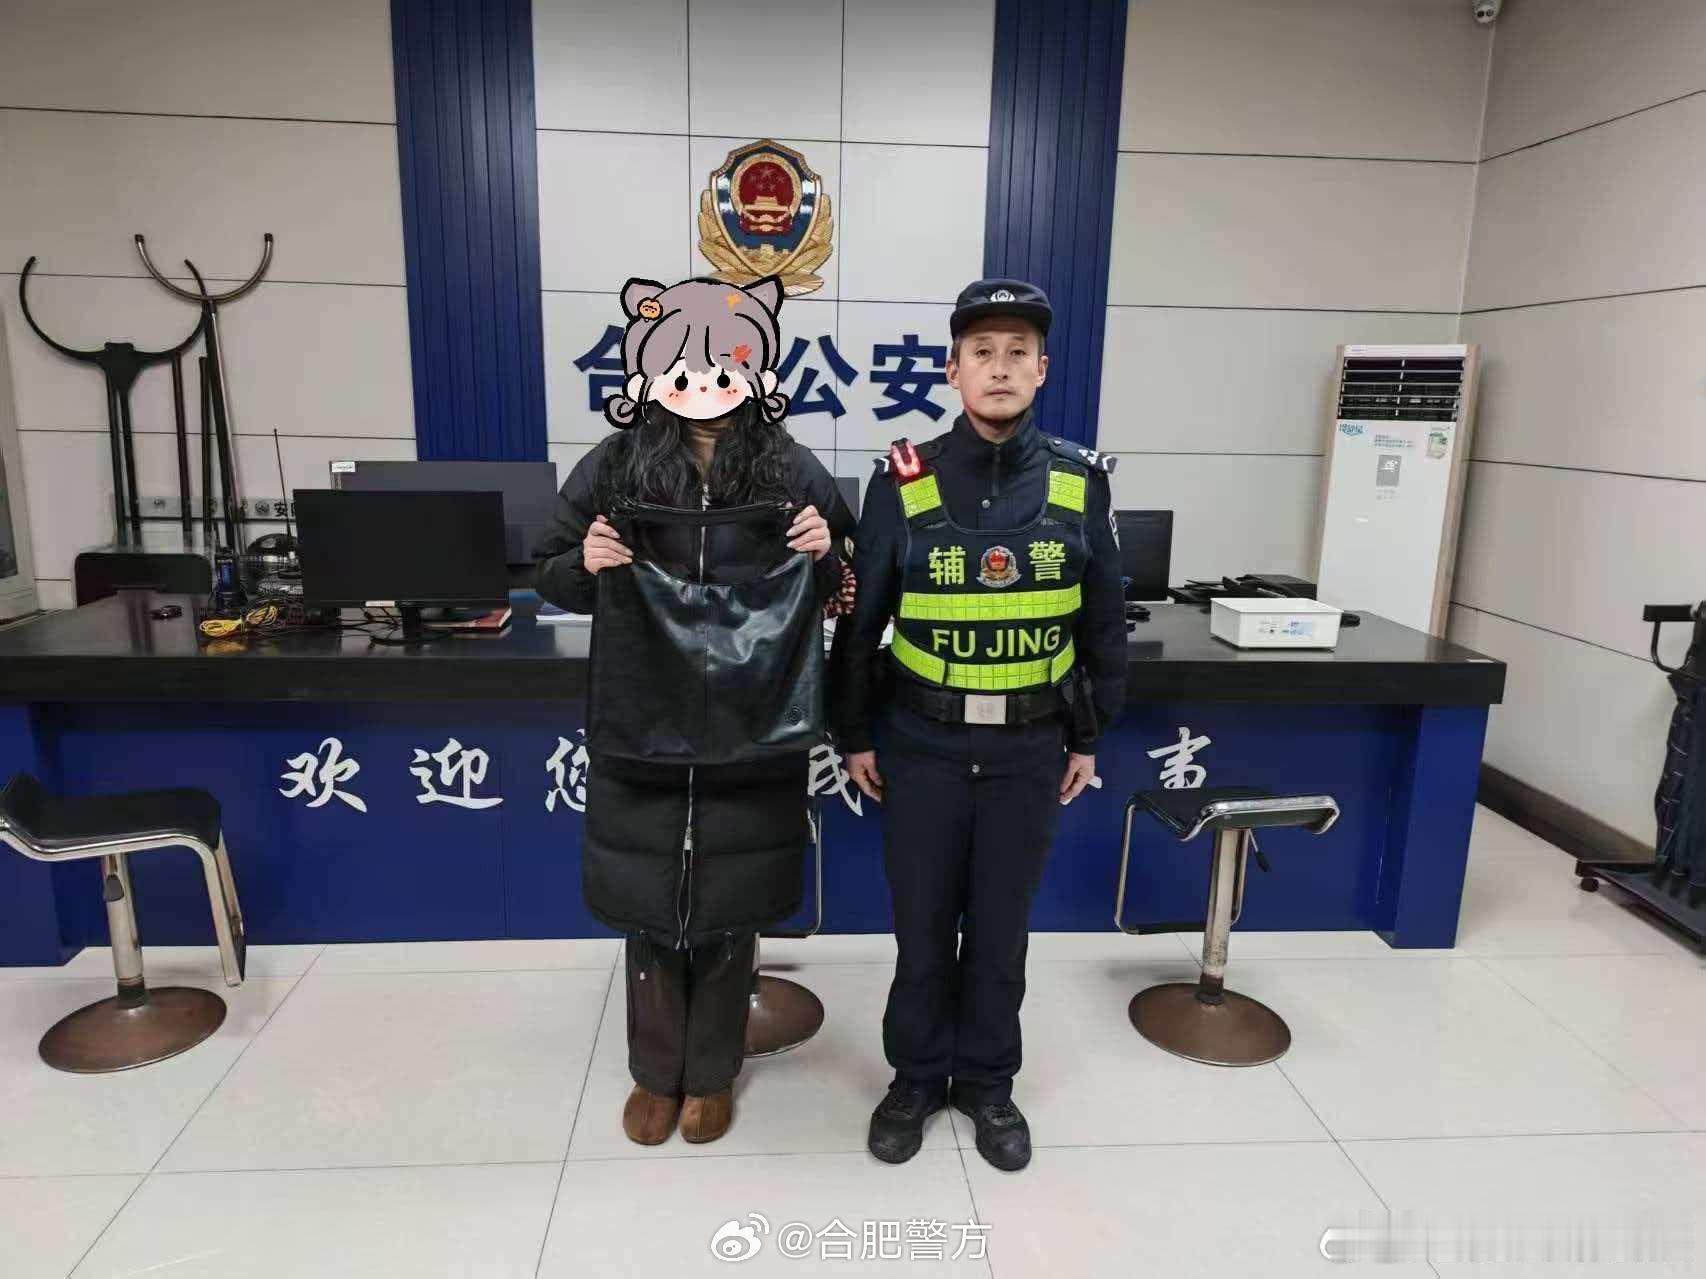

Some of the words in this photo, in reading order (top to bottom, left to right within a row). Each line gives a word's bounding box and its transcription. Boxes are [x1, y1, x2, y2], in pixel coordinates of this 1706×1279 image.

[573, 324, 949, 422] 合公安
[931, 628, 977, 658] FU
[985, 625, 1061, 657] JING
